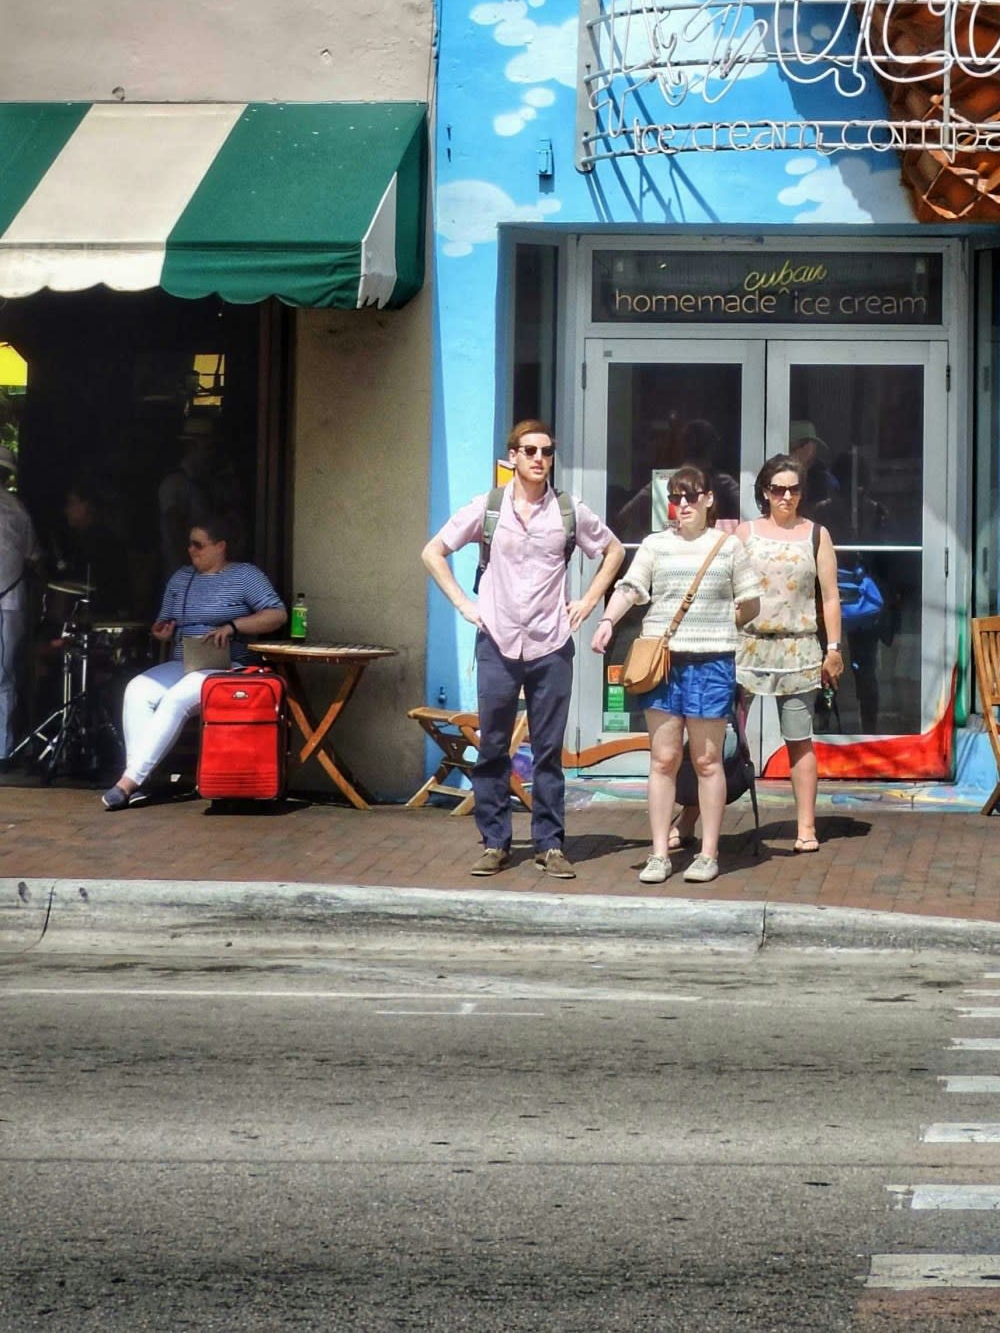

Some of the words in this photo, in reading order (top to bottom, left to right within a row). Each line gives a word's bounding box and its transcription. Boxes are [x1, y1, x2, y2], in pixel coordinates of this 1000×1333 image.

[743, 259, 828, 292] cuban
[615, 289, 777, 314] homemade
[794, 290, 831, 316] ice
[839, 295, 928, 315] cream
